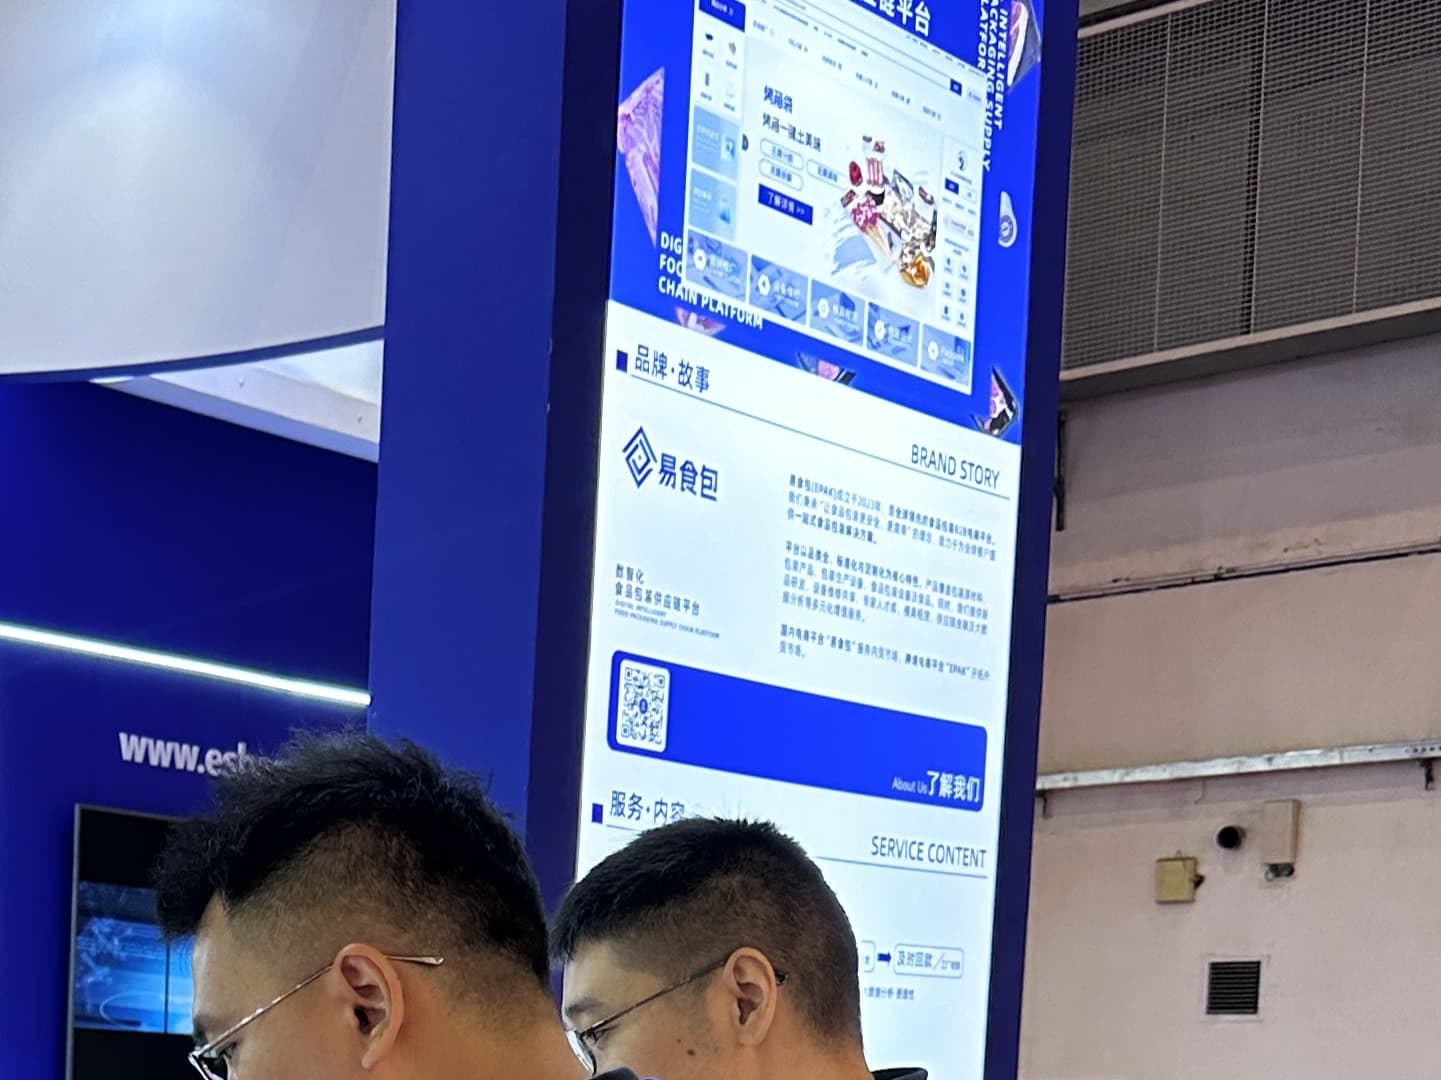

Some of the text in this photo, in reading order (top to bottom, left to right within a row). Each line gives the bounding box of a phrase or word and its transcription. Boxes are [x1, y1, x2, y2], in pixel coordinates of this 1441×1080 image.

[993, 8, 1008, 130] INTELLIGENT
[658, 276, 698, 305] CHAIN
[659, 452, 718, 502] 易食包
[911, 443, 1000, 490] BRAND STORY
[891, 776, 916, 793] About
[927, 770, 980, 803] 了解我们
[871, 835, 987, 868] SERVICE CONTENT
